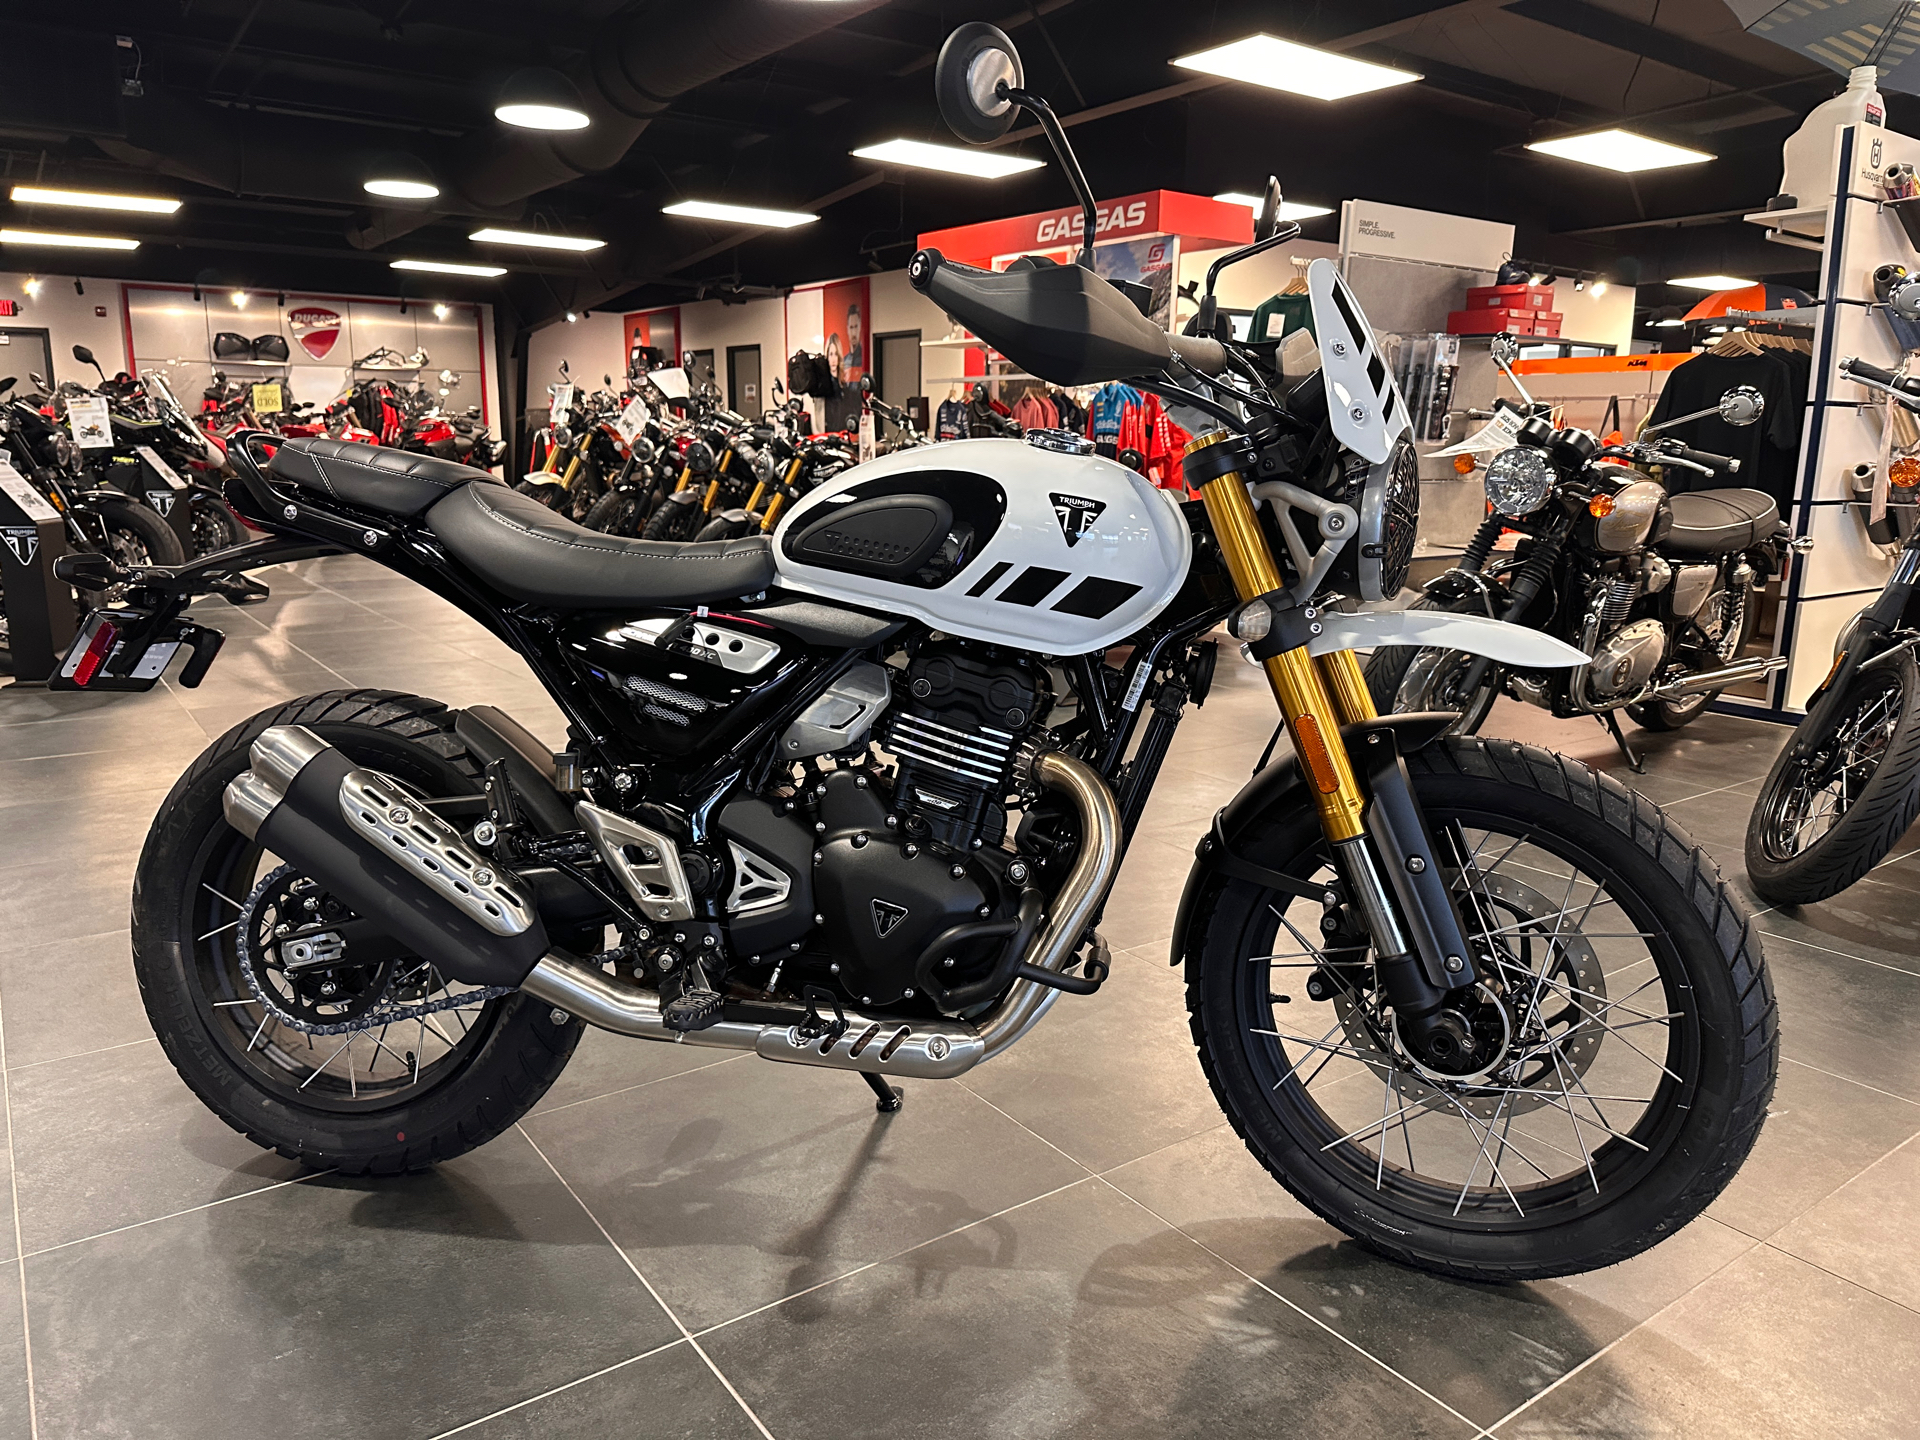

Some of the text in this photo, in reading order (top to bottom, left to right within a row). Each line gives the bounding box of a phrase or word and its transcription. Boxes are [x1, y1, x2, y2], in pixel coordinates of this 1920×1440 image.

[1359, 219, 1379, 229] SIMPLE.
[1358, 227, 1396, 239] PROGRESSIVE.
[294, 313, 337, 323] DUCATI
[1059, 496, 1096, 509] TRIUMPH
[700, 649, 717, 660] XC
